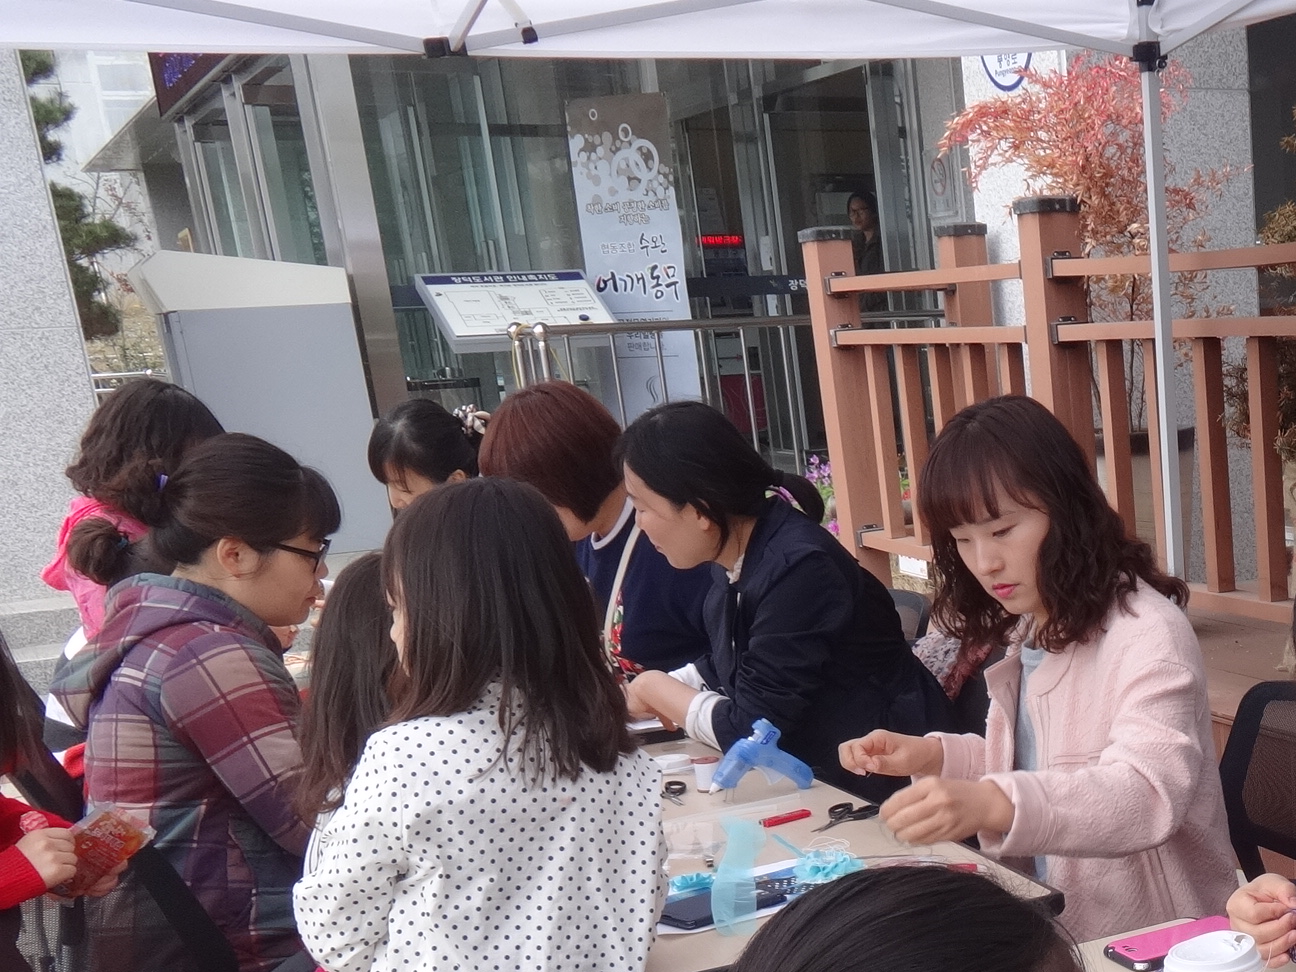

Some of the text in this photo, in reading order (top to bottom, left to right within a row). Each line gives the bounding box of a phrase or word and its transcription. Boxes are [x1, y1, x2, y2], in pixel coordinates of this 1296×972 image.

[604, 201, 621, 213] 소비
[600, 232, 667, 257] 협동조합 수완
[451, 275, 505, 284] 장덕도서관
[596, 264, 680, 301] 어깨동무
